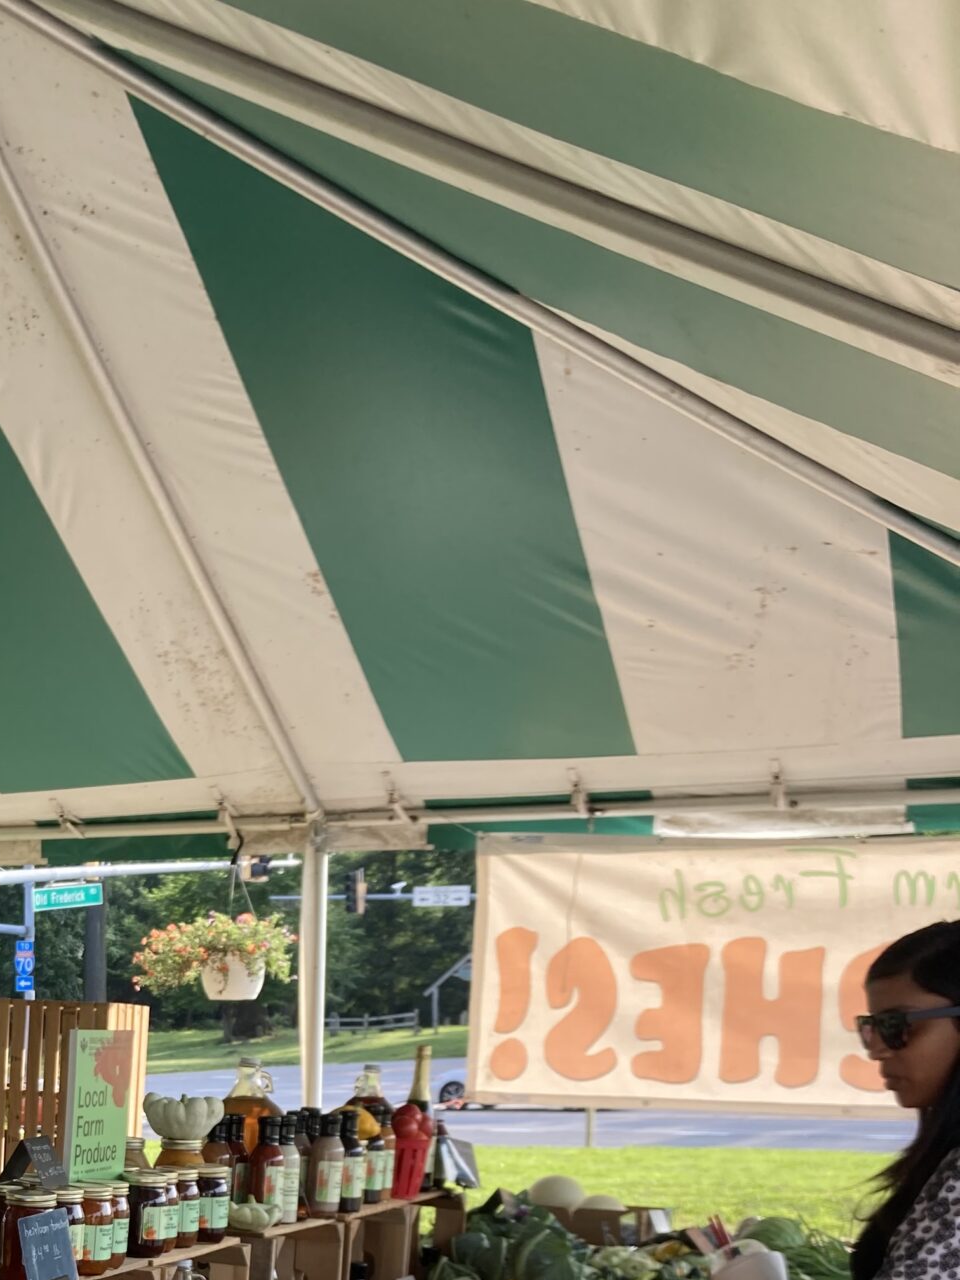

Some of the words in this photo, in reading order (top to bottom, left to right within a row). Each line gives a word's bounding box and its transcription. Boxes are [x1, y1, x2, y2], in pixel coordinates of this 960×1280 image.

[35, 893, 48, 906] Old
[51, 889, 86, 905] Frederick
[17, 957, 33, 973] 70
[78, 1085, 108, 1109] Local
[76, 1115, 105, 1138] Farm
[73, 1142, 117, 1166] Produce
